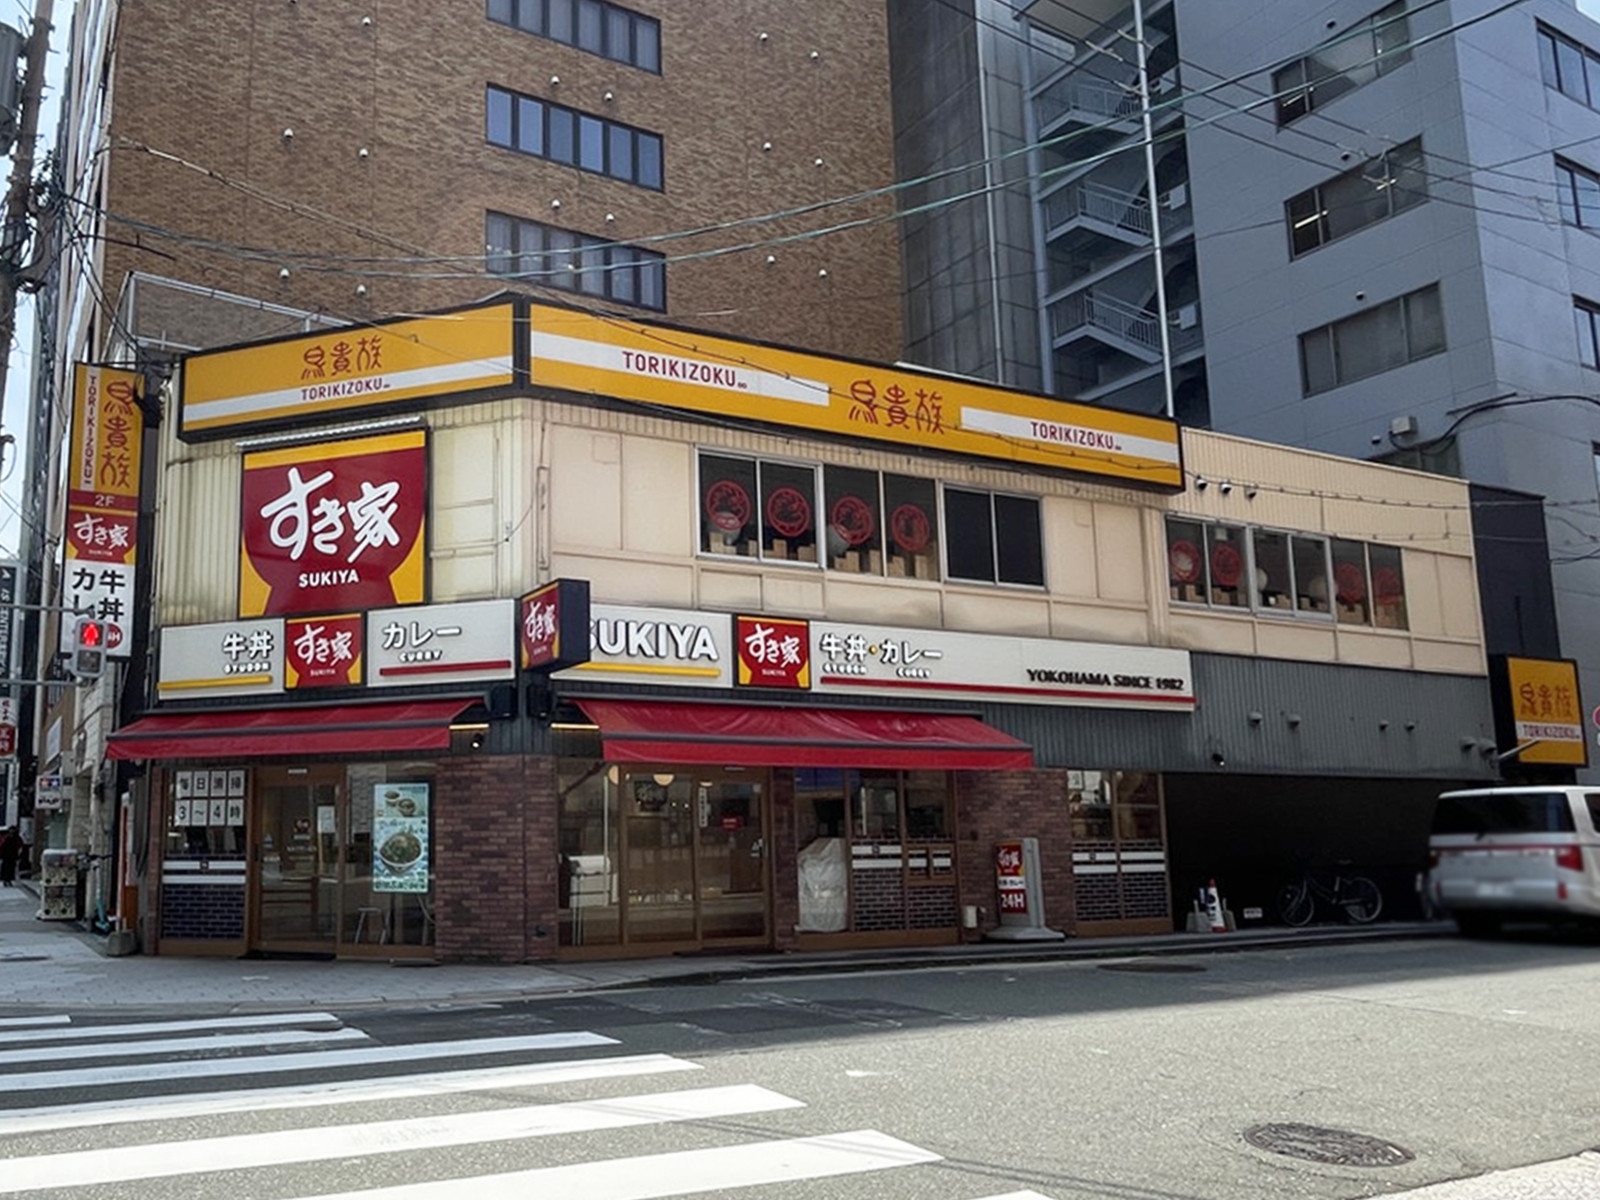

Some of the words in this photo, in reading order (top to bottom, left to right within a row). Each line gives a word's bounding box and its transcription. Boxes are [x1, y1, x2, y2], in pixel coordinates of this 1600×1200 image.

[301, 335, 382, 380] 鳥貴族
[622, 351, 736, 387] TORIKIZOKU
[301, 378, 383, 401] TORIKIZOKU
[848, 379, 945, 435] 鳥貴族
[84, 376, 97, 479] TORIKIZOKU
[100, 381, 133, 489] 鳥貴族
[1030, 421, 1114, 450] TORIKIZOKU
[94, 494, 115, 507] 2F
[260, 467, 400, 564] すき家
[73, 513, 129, 549] すき家
[97, 569, 126, 623] 牛丼
[299, 569, 360, 588] SUKIYA
[382, 621, 462, 650] カレー
[525, 601, 556, 643] すき家
[222, 630, 275, 661] 牛丼
[293, 624, 353, 667] すき家
[745, 624, 801, 668] すき家
[1026, 668, 1111, 686] YOKOHAMA
[1114, 674, 1152, 689] SINCE
[1000, 893, 1025, 908] 24H
